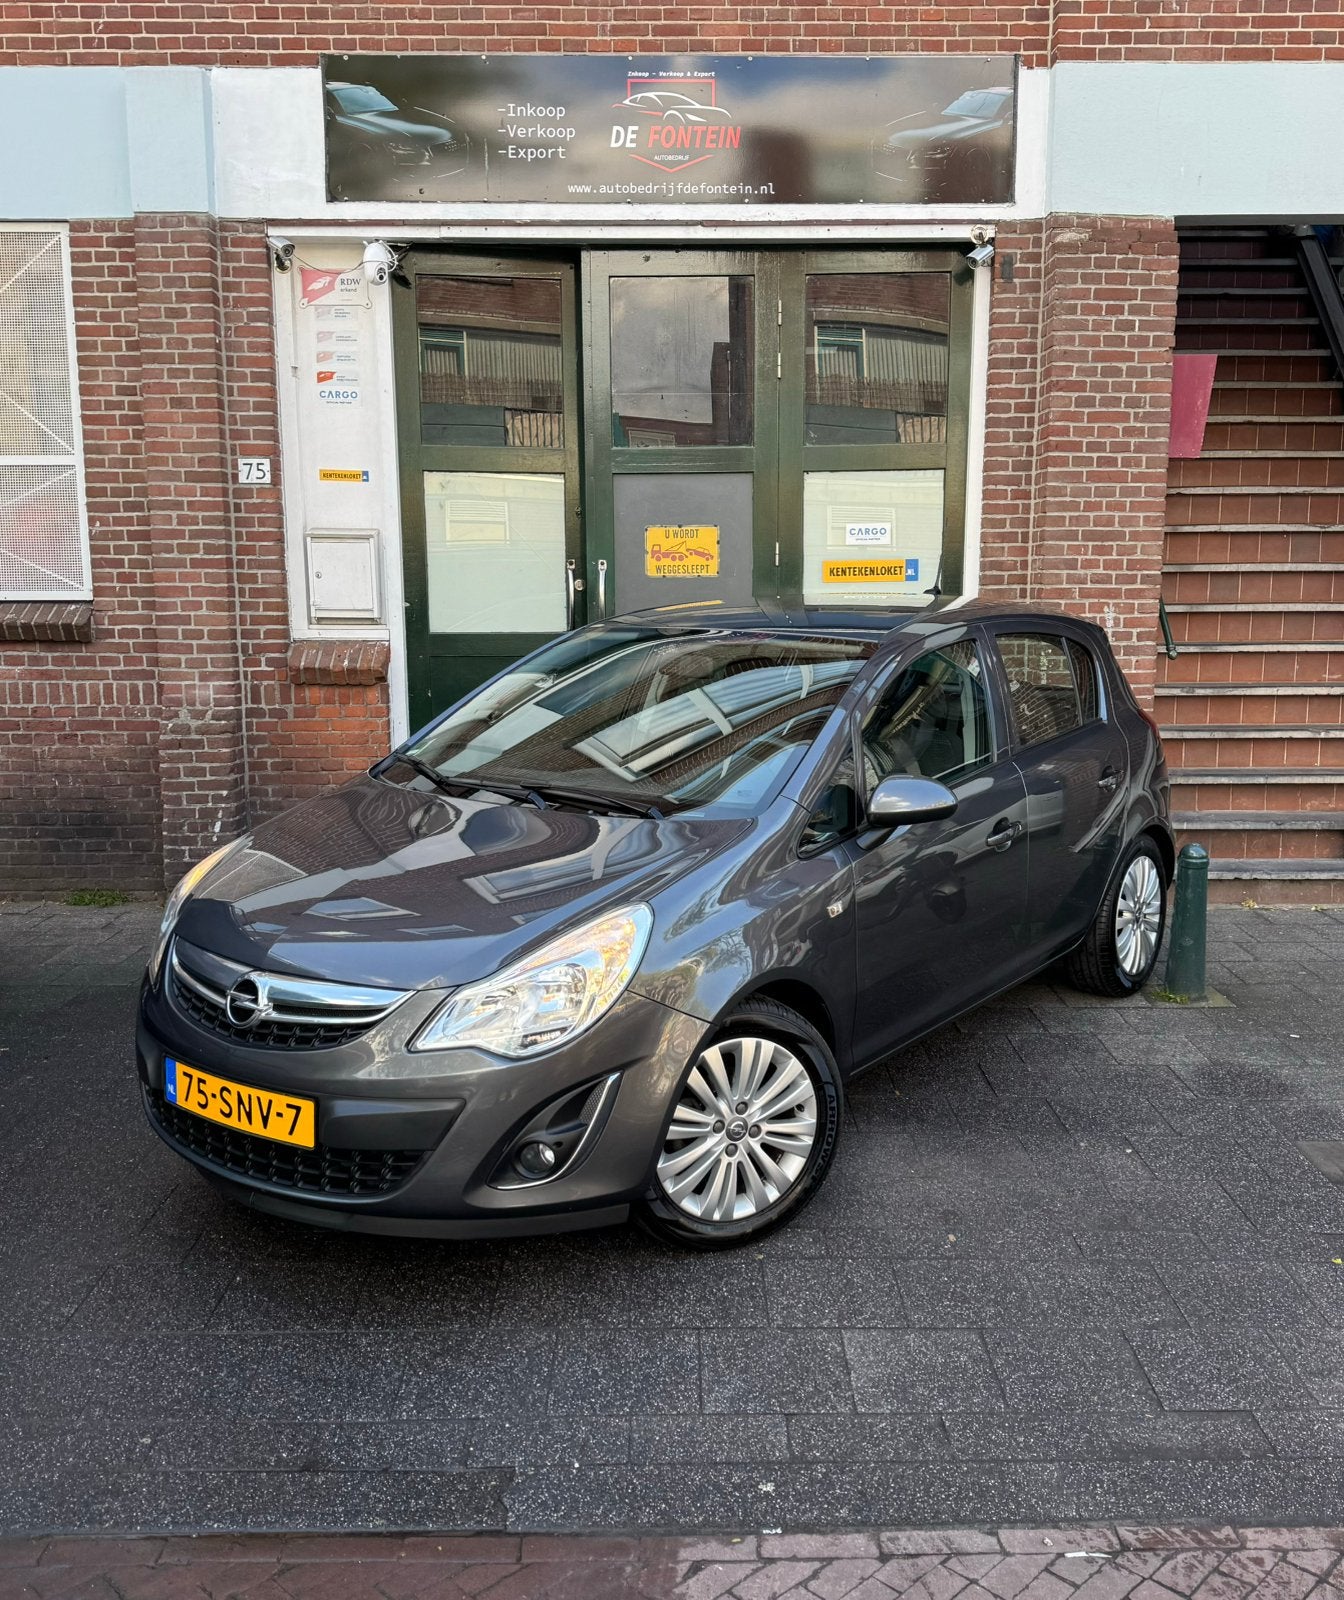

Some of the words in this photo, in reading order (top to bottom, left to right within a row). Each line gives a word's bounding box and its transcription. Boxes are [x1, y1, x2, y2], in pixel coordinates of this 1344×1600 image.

[610, 125, 639, 148] DE
[648, 125, 741, 148] FONTEIN
[568, 183, 775, 196] www.autobedrijfdefontein.nl
[340, 278, 361, 286] RDW
[319, 390, 358, 399] CARGO
[242, 462, 266, 480] 75
[664, 528, 670, 539] U
[672, 528, 699, 539] WORDT
[849, 527, 887, 536] CARGO
[655, 564, 710, 575] WEGGESLEEPT
[182, 1071, 302, 1136] 75-SNV-7
